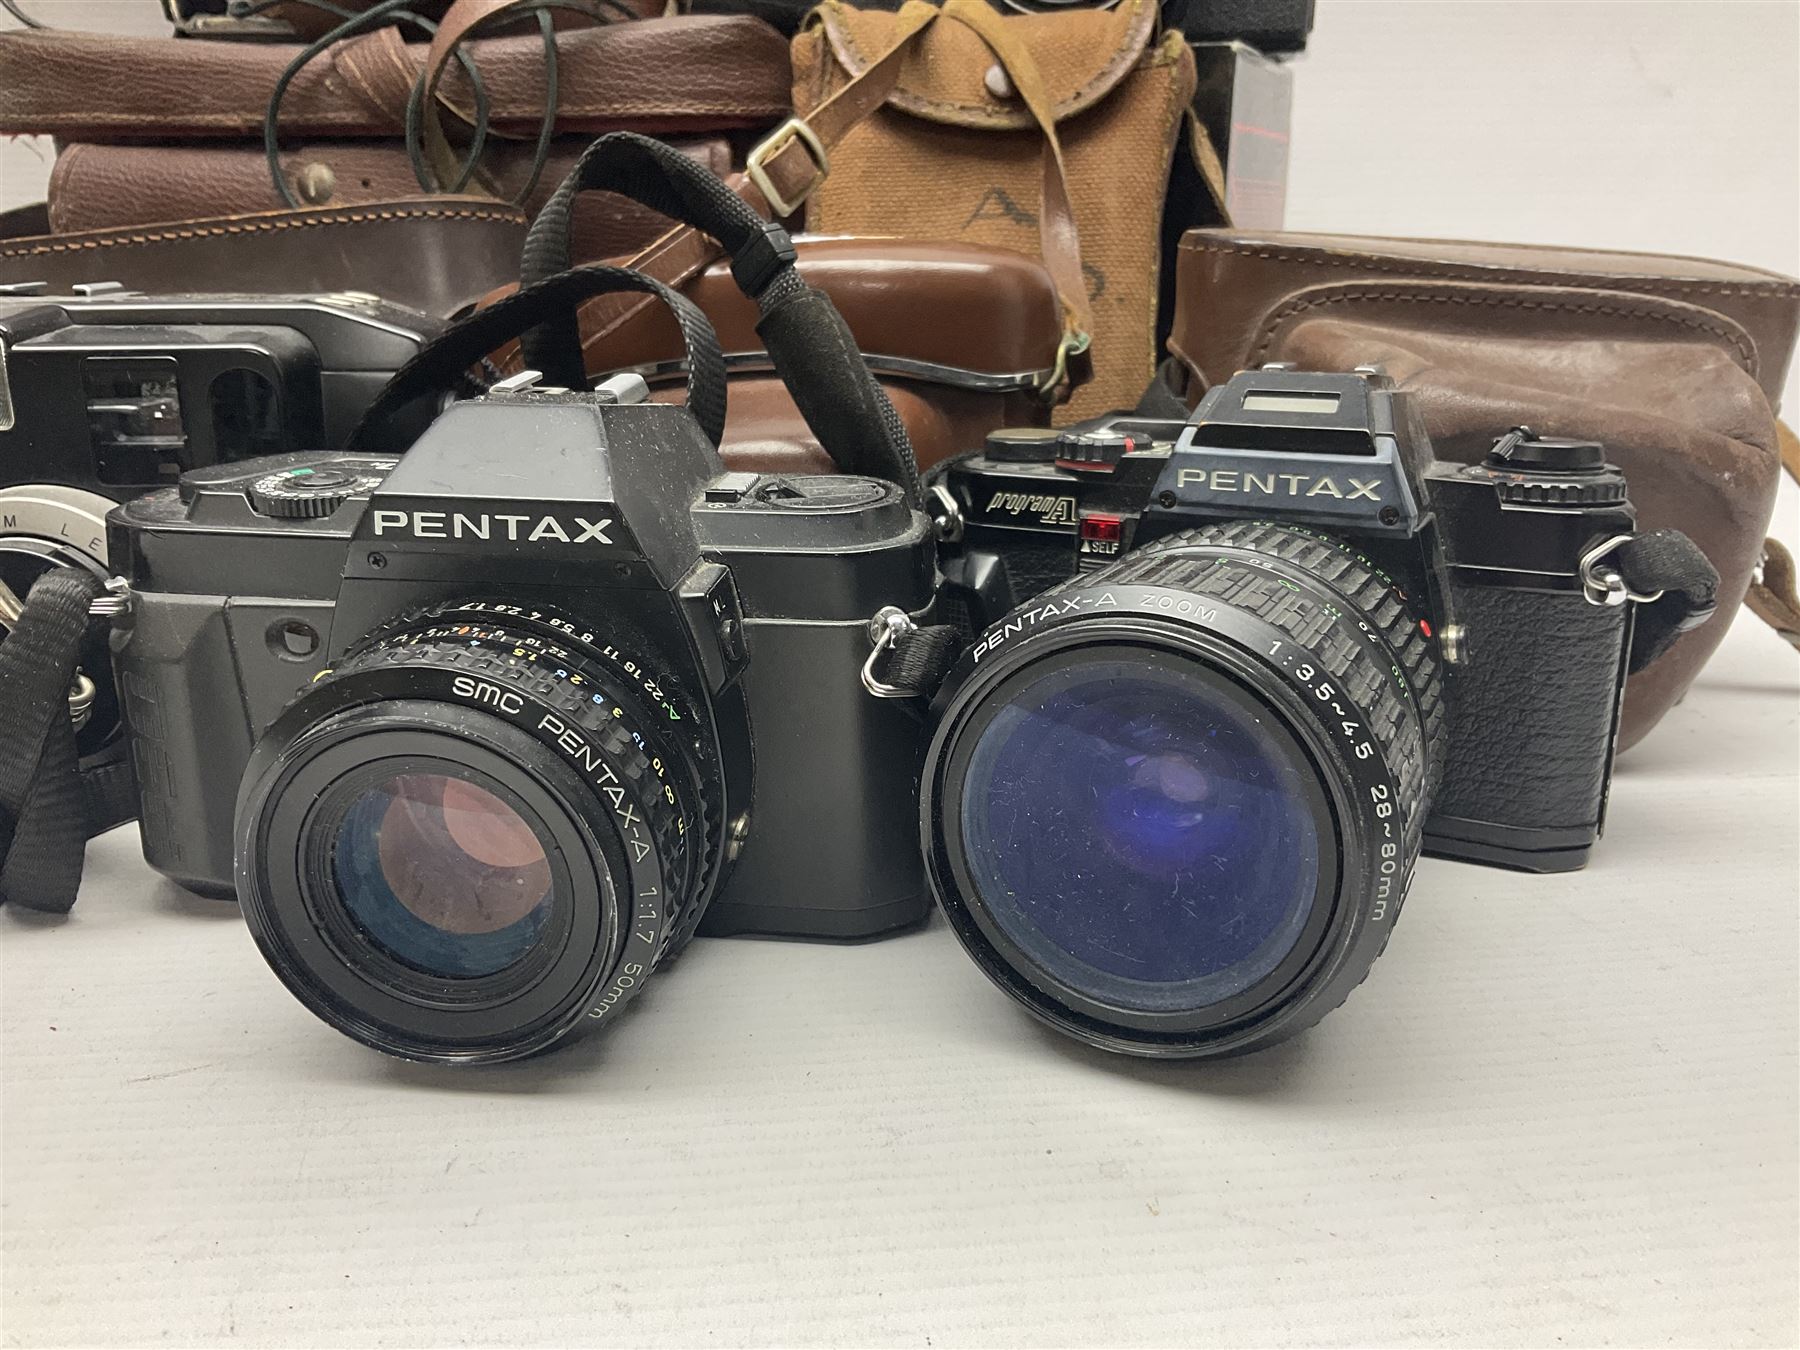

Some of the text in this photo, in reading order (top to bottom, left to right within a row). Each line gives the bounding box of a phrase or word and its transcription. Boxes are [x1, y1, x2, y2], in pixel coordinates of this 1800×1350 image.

[1177, 468, 1383, 502] PENTAX
[373, 510, 613, 545] PENTAX
[1092, 541, 1119, 554] SELF
[549, 618, 575, 634] 5.6
[581, 633, 594, 643] 8
[603, 645, 619, 660] 11
[623, 661, 642, 679] 16
[644, 679, 664, 701] 22
[972, 592, 1118, 663] PENTAX-A
[1140, 594, 1217, 623] ZOOM
[1370, 784, 1397, 921] 28~80mm
[538, 713, 650, 863] PENTAX-A
[636, 886, 658, 944] 1:1.7
[588, 962, 623, 1019] 50mm
